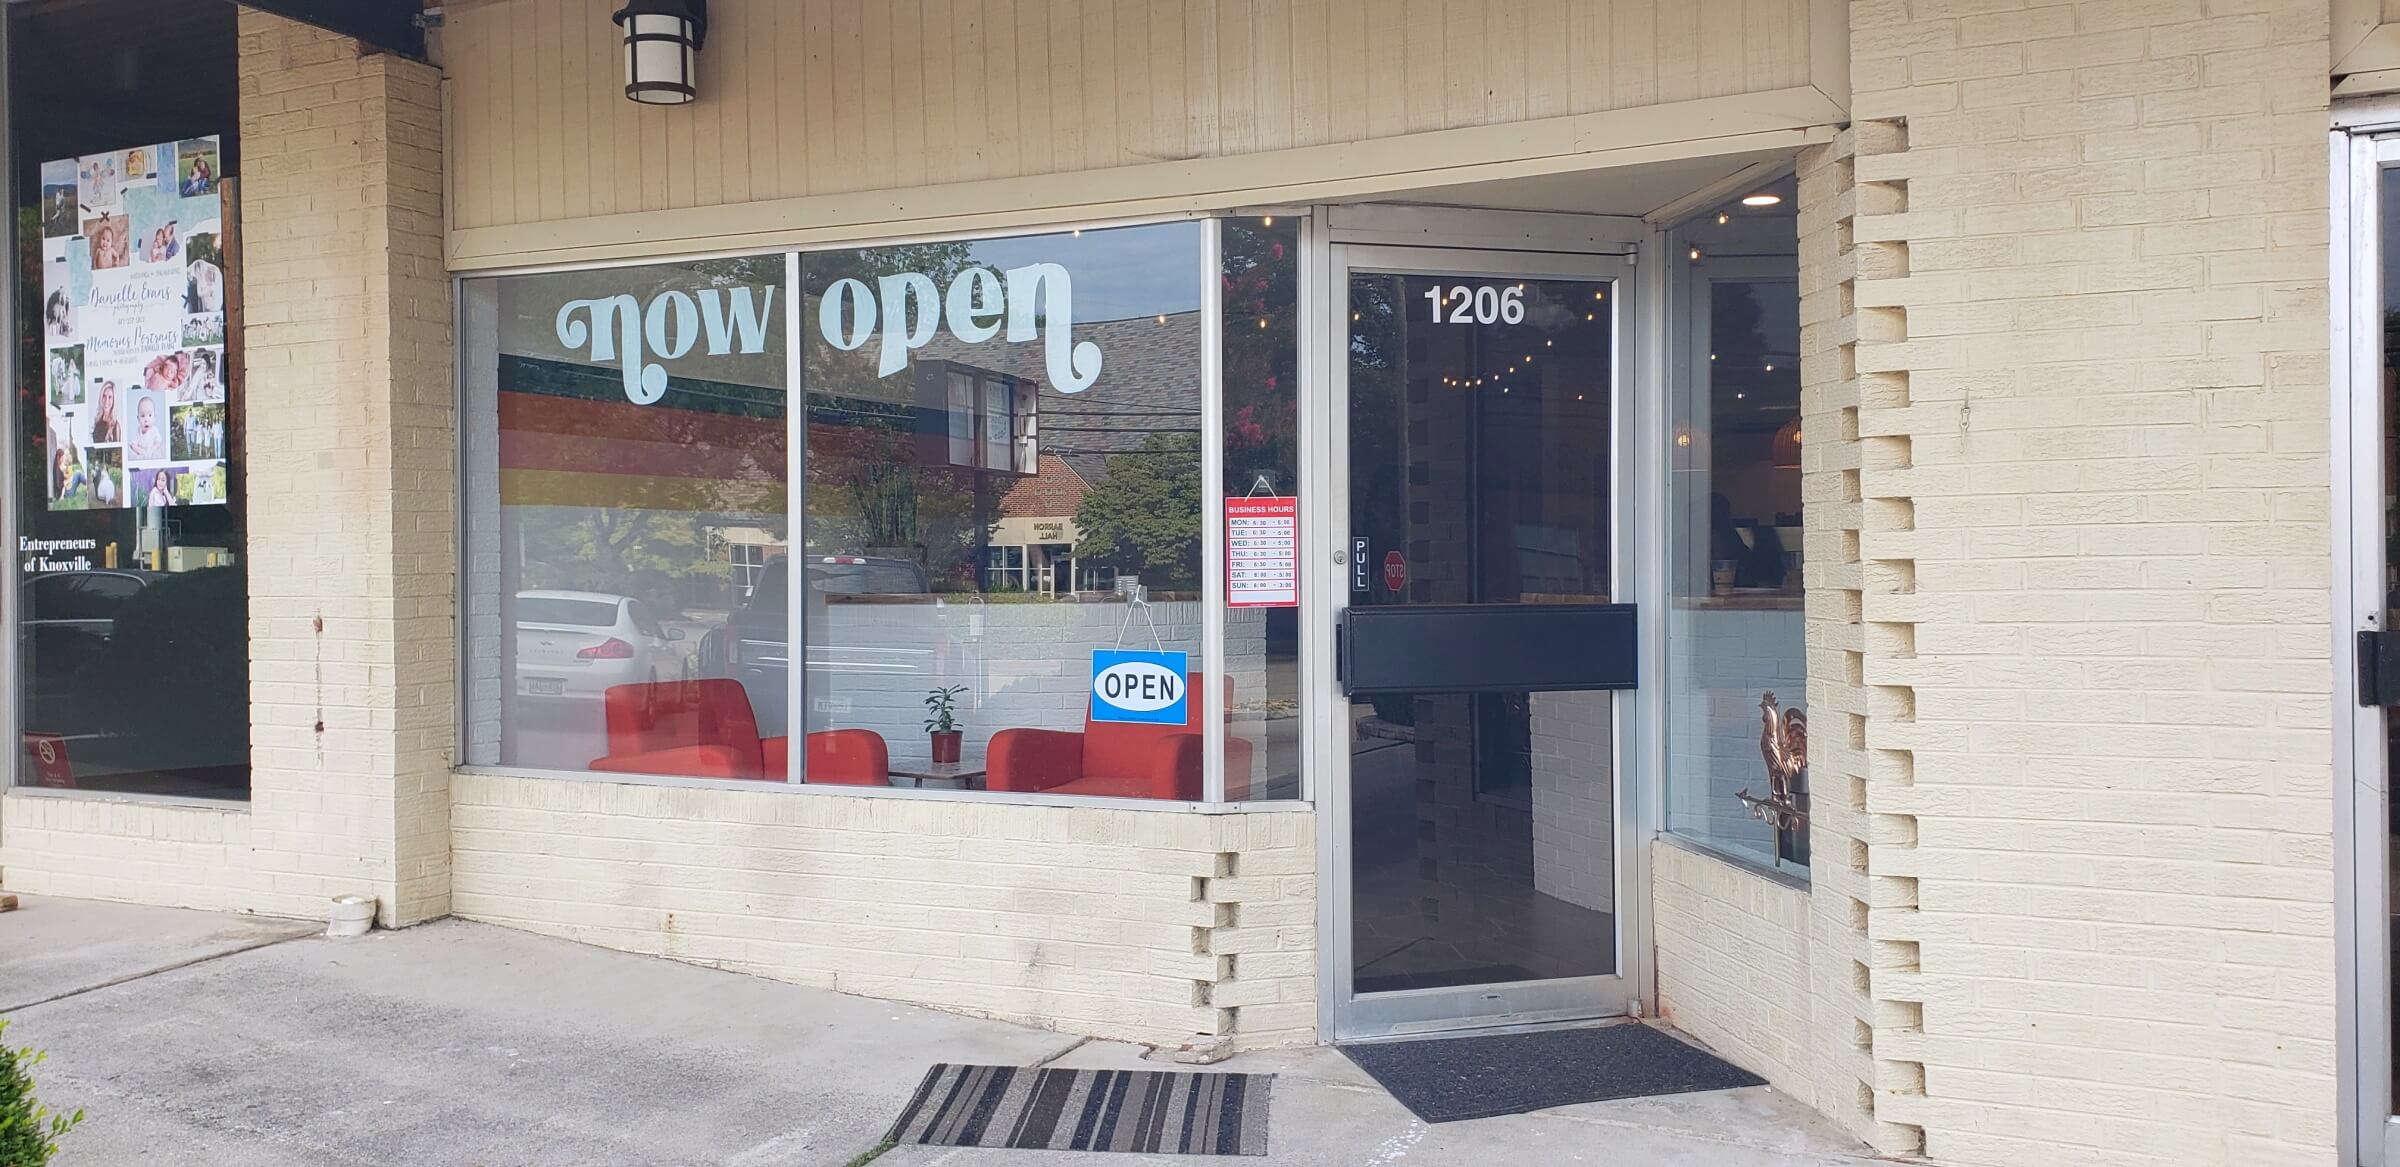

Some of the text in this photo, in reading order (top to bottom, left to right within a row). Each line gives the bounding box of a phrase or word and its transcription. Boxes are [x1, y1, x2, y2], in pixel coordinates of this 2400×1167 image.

[141, 281, 171, 301] Evans
[1424, 285, 1525, 325] 1206
[556, 262, 1103, 405] now open
[1228, 505, 1294, 514] BUSINESS HOURS
[20, 536, 96, 555] Entrepreneurs
[24, 556, 91, 572] of Knoxville
[1356, 540, 1366, 588] PULL
[1105, 673, 1174, 700] OPEN
